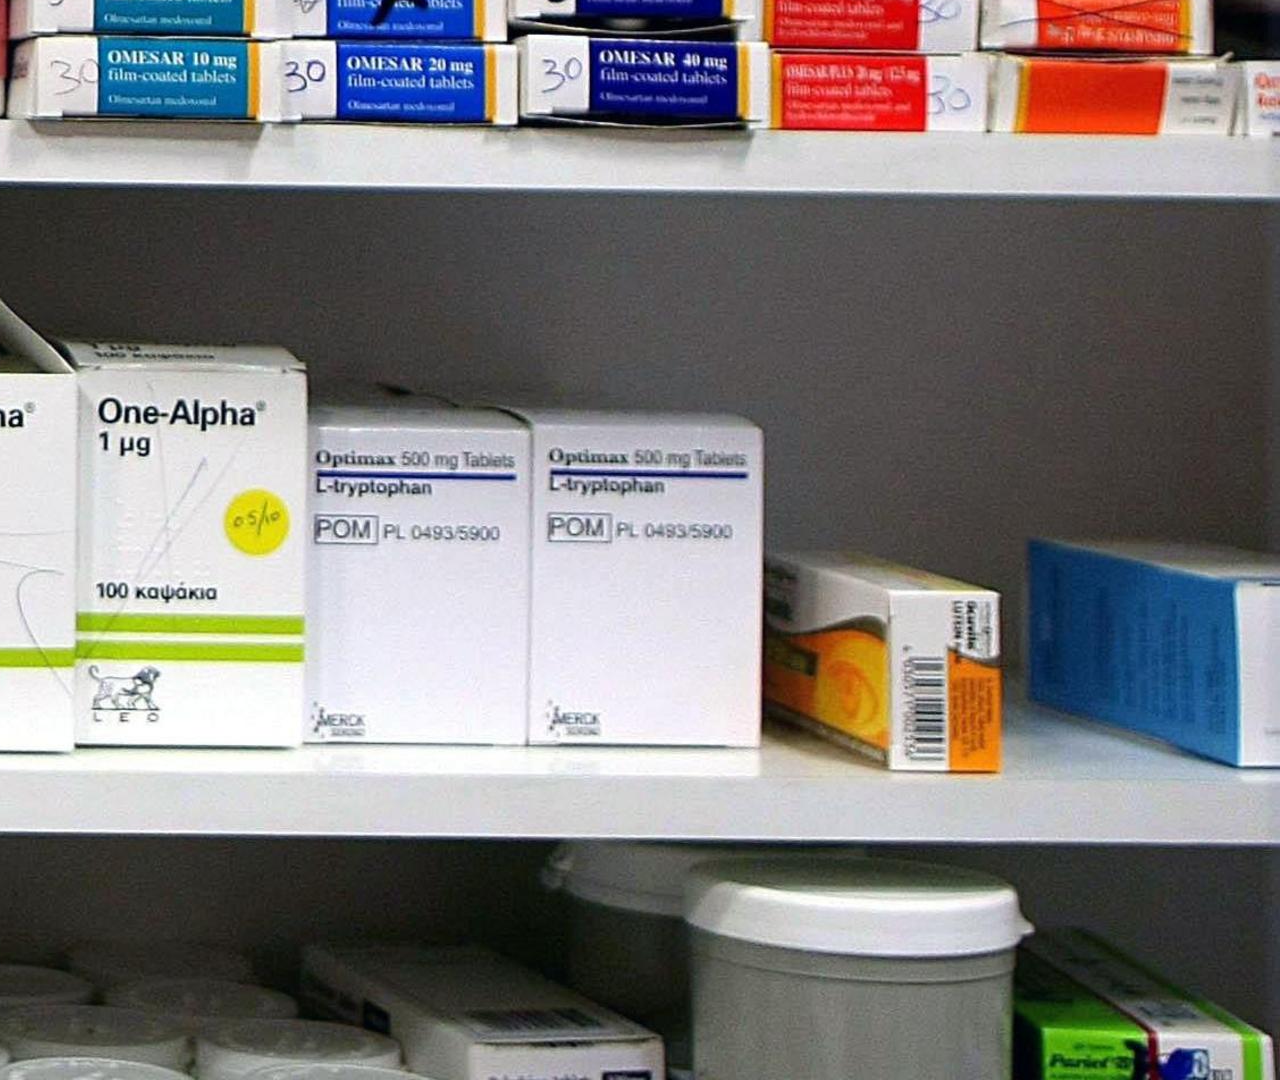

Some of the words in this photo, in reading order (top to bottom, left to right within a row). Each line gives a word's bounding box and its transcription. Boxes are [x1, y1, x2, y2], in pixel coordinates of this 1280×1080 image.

[107, 49, 184, 66] OMESAR
[192, 51, 207, 67] 10
[212, 54, 237, 70] mg
[347, 56, 424, 73] OMESAR
[429, 58, 446, 73] 20
[450, 60, 473, 76] mg
[598, 50, 677, 68] OMESAR
[683, 52, 703, 68] 40
[705, 54, 728, 71] mg
[107, 68, 189, 84] film-coated
[193, 70, 237, 84] tablets
[284, 61, 326, 93] 30
[347, 75, 428, 90] film-coated
[431, 76, 474, 90] tablets
[98, 398, 256, 431] One-Alpha
[99, 431, 110, 453] 1
[116, 433, 151, 457] µg
[316, 449, 395, 472] Optimax
[401, 452, 430, 469] 500
[434, 455, 457, 472] mg
[462, 451, 515, 469] Tablets
[316, 478, 432, 499] L-tryptophan
[317, 518, 372, 540] POM
[383, 525, 405, 542] PL
[411, 523, 501, 543] 0493/5900
